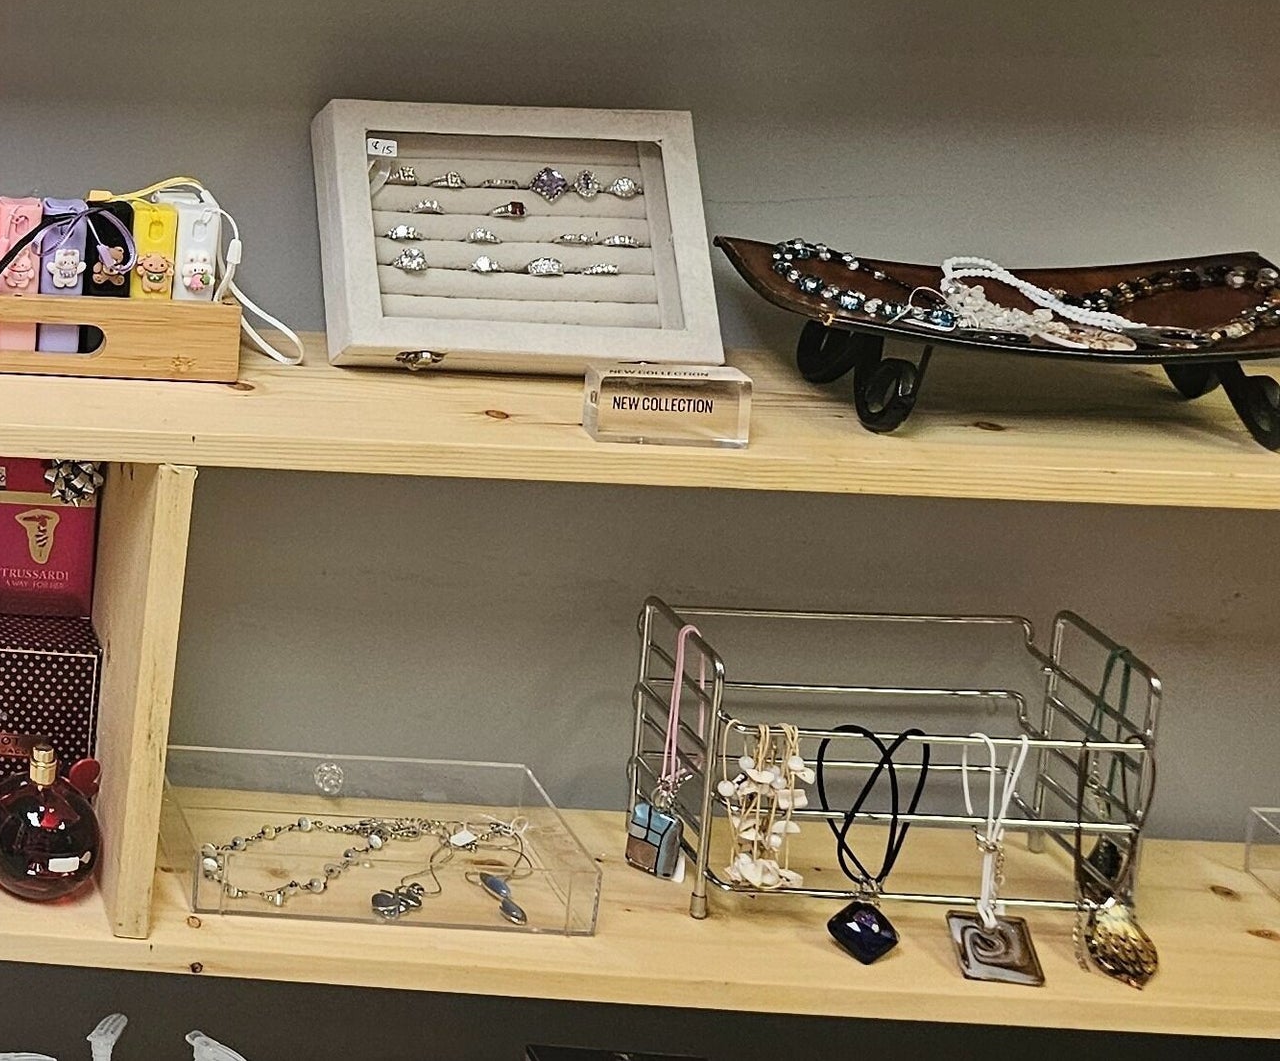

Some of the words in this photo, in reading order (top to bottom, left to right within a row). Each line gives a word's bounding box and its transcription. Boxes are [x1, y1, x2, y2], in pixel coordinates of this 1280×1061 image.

[612, 396, 640, 411] NEW
[642, 397, 714, 413] COLLECTION
[0, 568, 69, 581] TRUSSARDI
